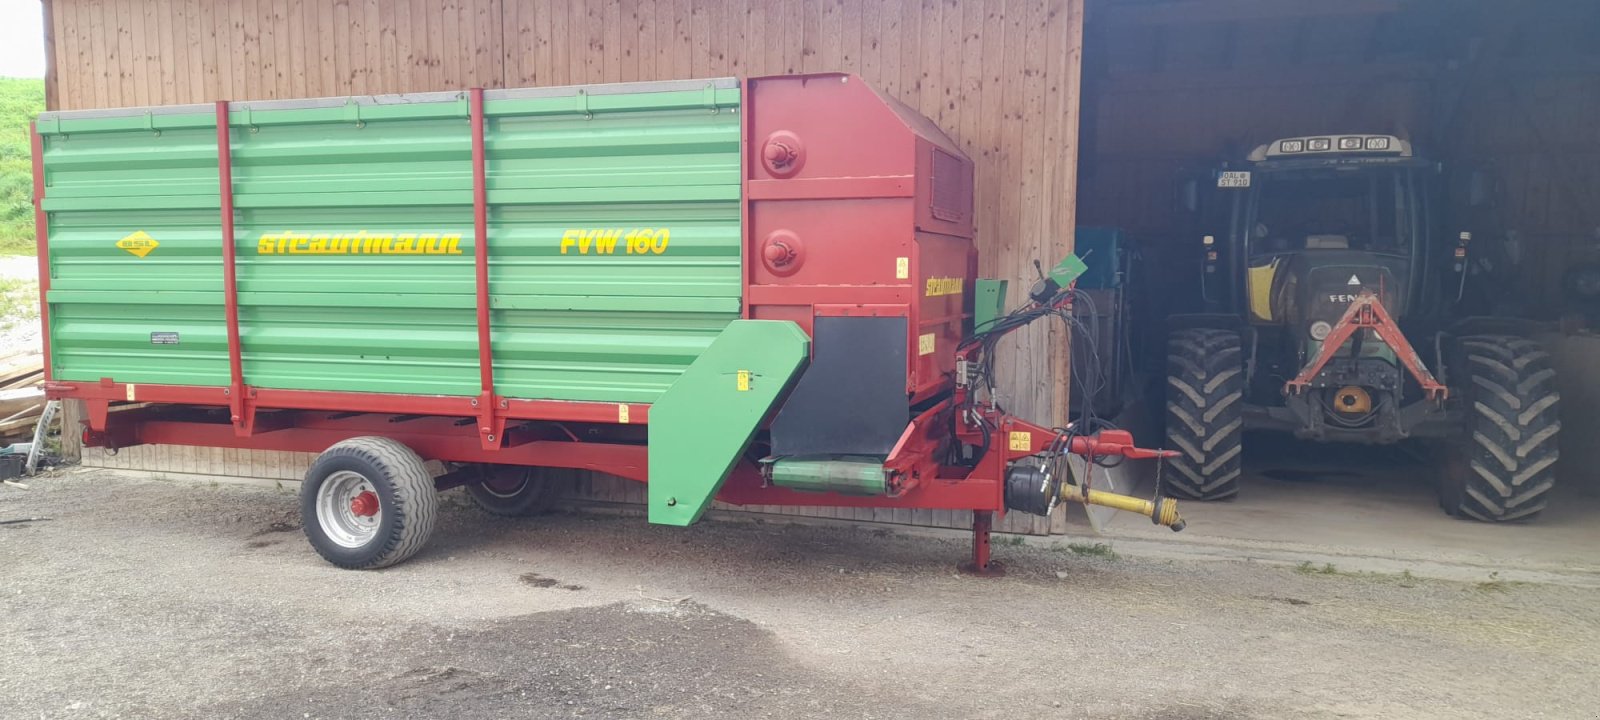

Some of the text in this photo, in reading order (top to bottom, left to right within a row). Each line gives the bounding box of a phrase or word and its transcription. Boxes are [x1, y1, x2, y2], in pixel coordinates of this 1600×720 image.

[258, 230, 463, 254] strautmann
[560, 228, 670, 254] FVW 160
[1329, 293, 1378, 303] FEN
